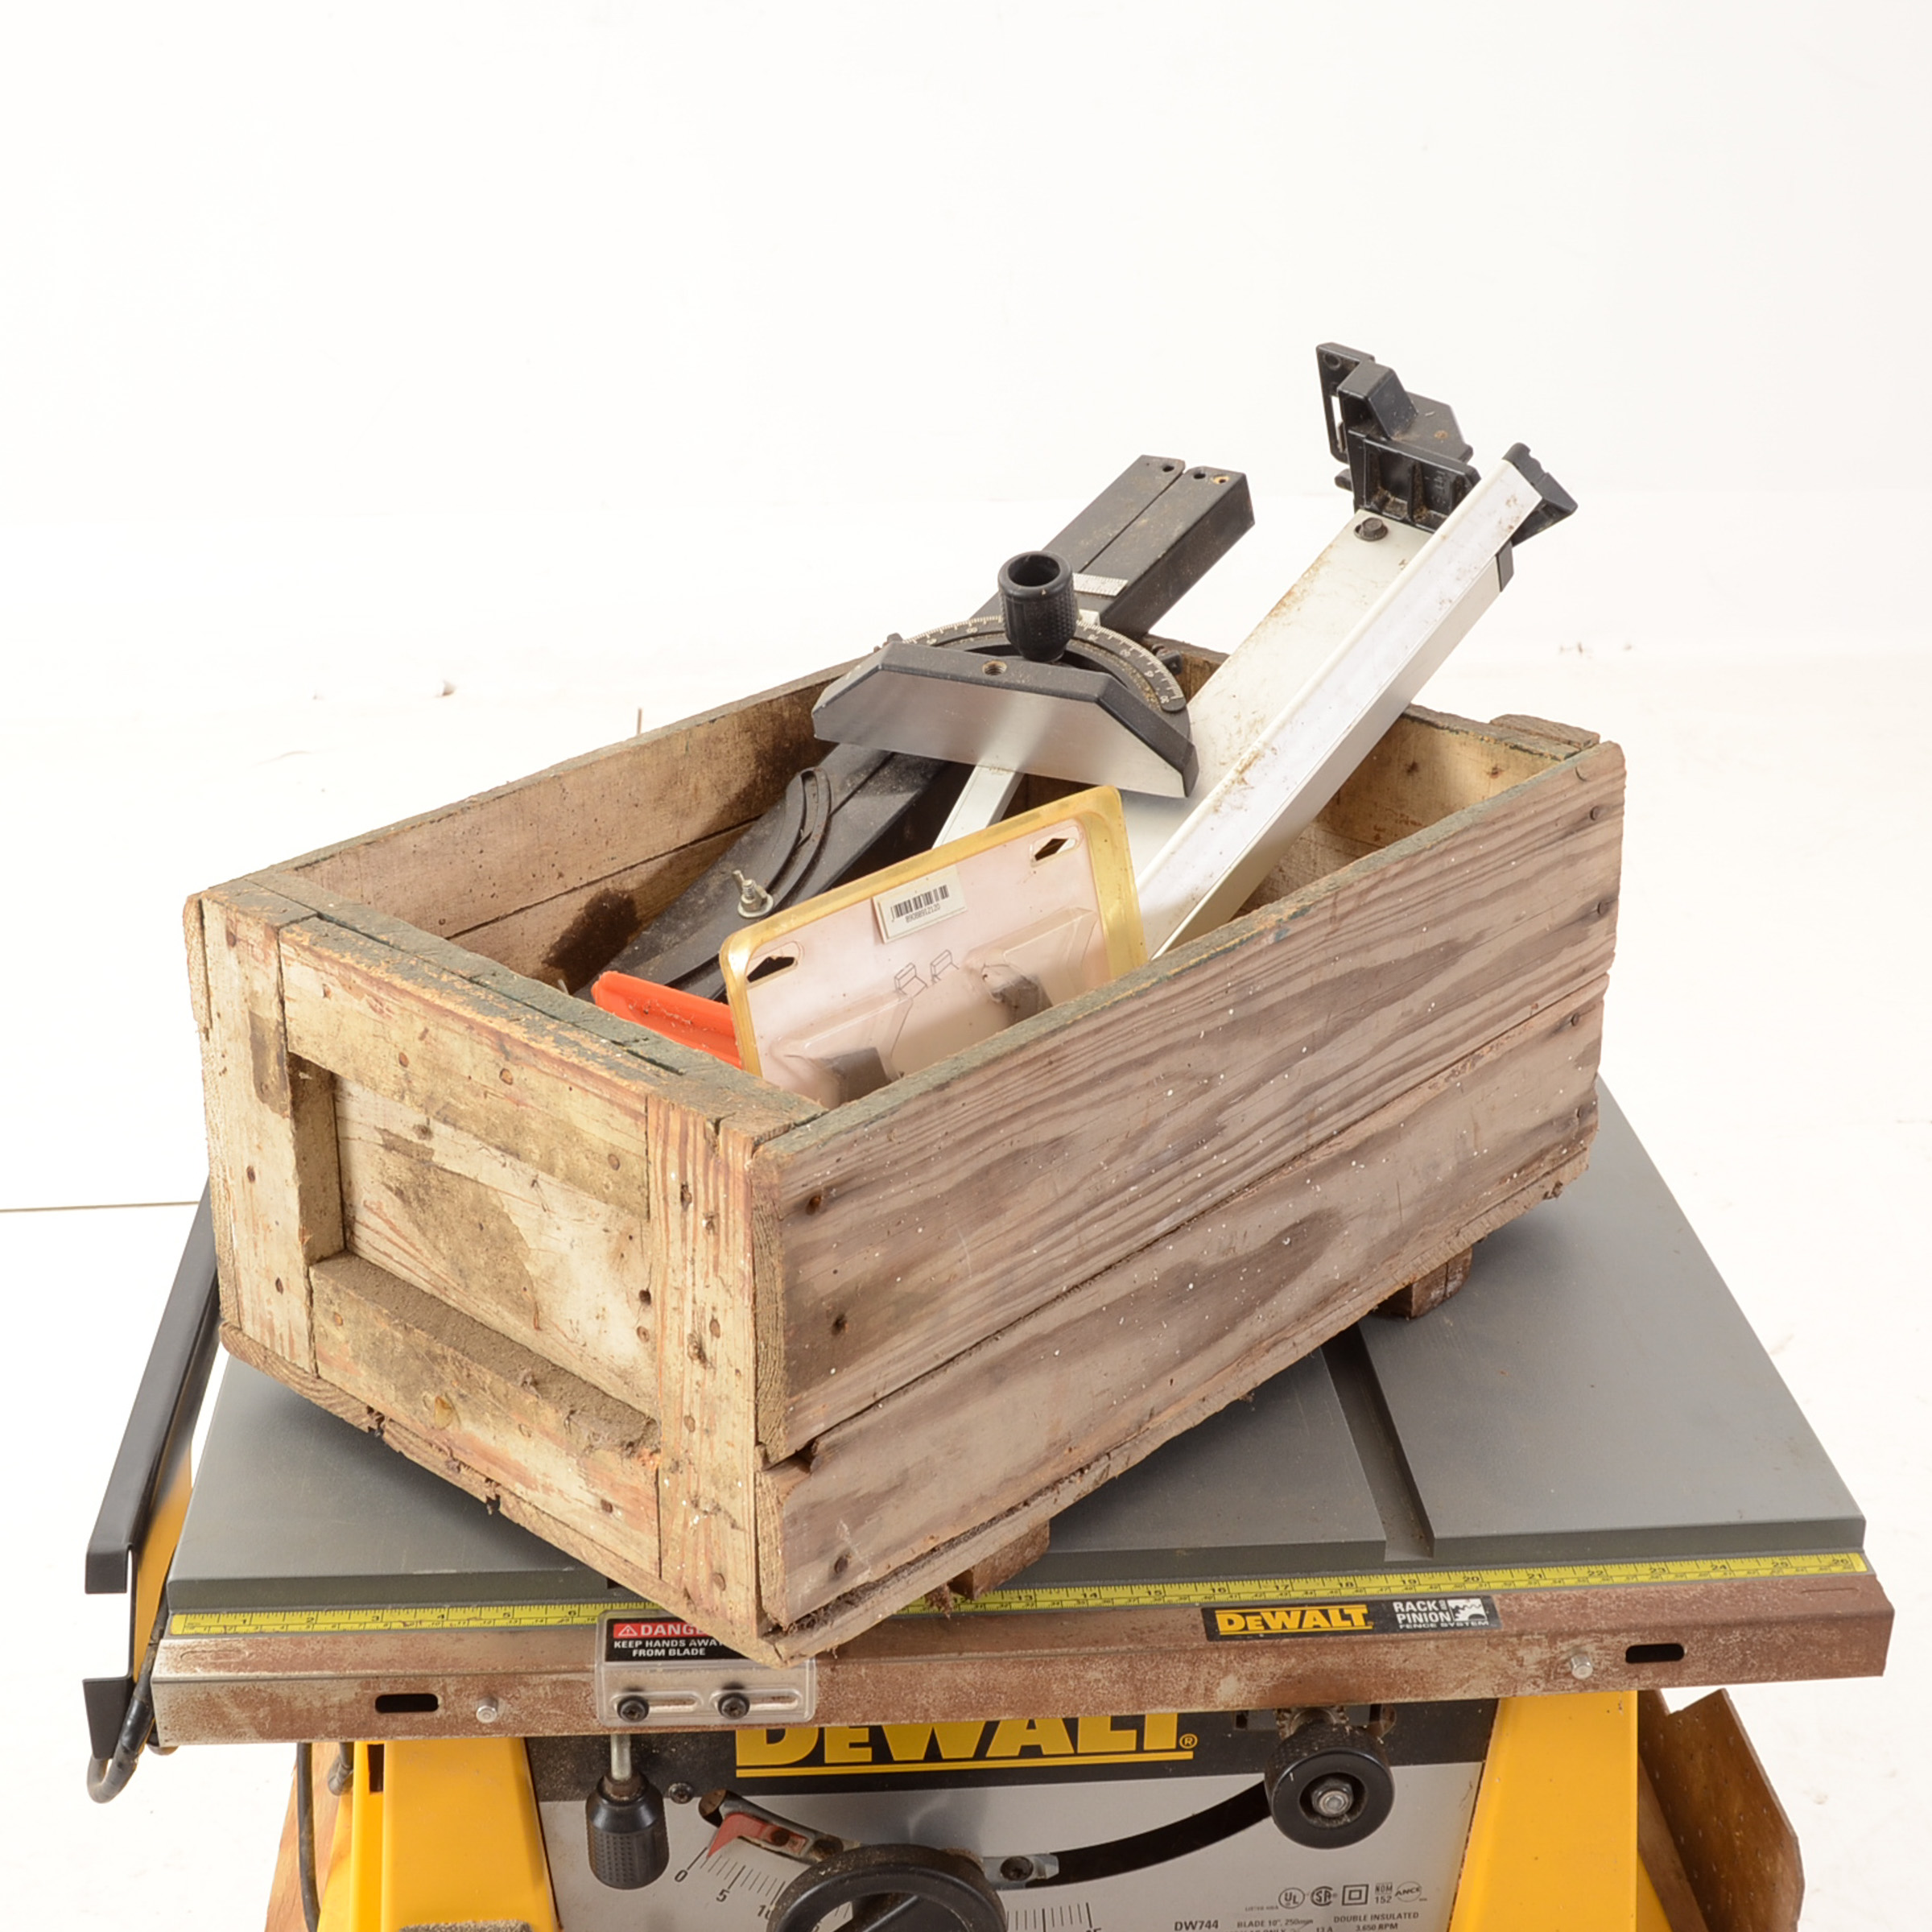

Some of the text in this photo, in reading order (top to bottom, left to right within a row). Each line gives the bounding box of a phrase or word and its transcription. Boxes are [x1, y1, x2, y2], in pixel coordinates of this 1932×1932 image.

[1393, 1599, 1439, 1612] RACK
[1397, 1612, 1451, 1624] PINION
[641, 1623, 707, 1636] DANG
[614, 1640, 643, 1649] KEEP
[645, 1639, 686, 1648] HANDS
[632, 1647, 706, 1657] FROM BLADE
[674, 1869, 688, 1883] 0
[716, 1889, 730, 1902] 5
[1375, 1896, 1393, 1904] 152
[1333, 1911, 1420, 1923] DOUBLE INSULATED
[1174, 1919, 1219, 1931] DW744
[1236, 1920, 1265, 1929] BLADE
[1378, 1922, 1399, 1930] RPM
